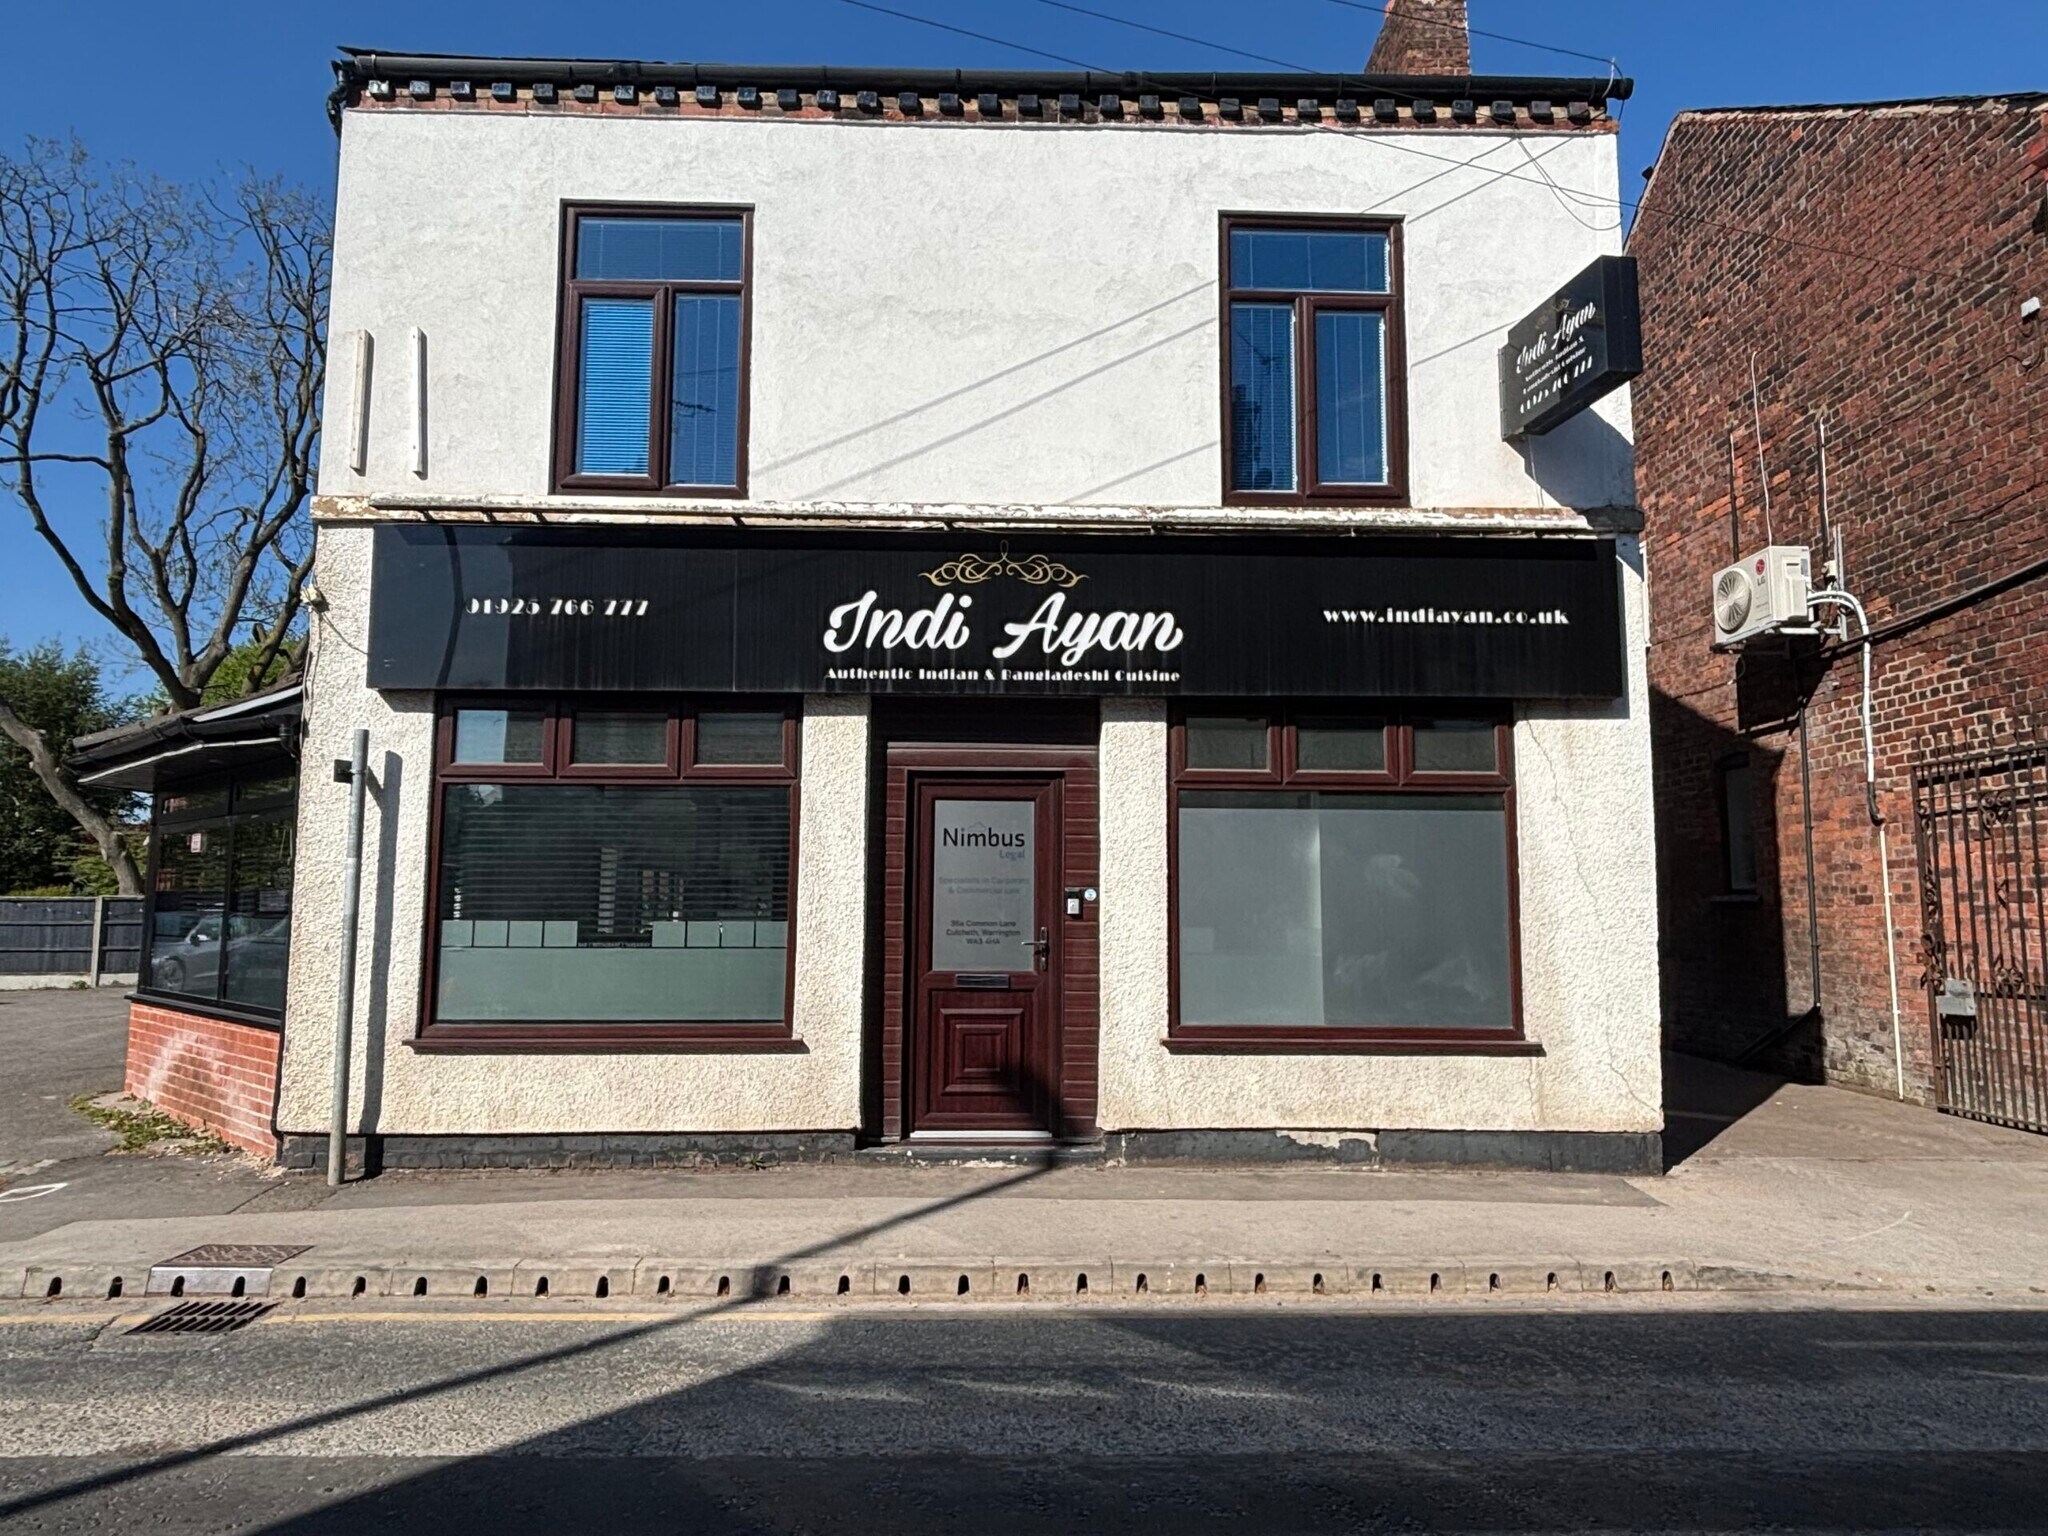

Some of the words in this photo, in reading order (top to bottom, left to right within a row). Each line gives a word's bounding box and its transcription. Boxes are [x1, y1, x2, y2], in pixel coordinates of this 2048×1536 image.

[1516, 331, 1547, 374] Indi
[1551, 302, 1596, 351] Ayan
[1757, 575, 1766, 586] LG
[465, 598, 540, 615] 01925
[550, 599, 595, 616] 766
[603, 600, 649, 616] 777
[1323, 607, 1570, 624] www.indiayan.co.uk
[823, 590, 973, 653] Indi
[992, 591, 1184, 667] Ayan
[826, 667, 913, 679] Authentic
[918, 668, 979, 680] Indian
[984, 669, 995, 680] &
[1001, 669, 1110, 682] Bangladeshi
[1114, 670, 1180, 682] Cuisine
[943, 827, 1025, 848] Nimbus
[1000, 849, 1025, 861] Legal
[982, 929, 1021, 938] Warrington
